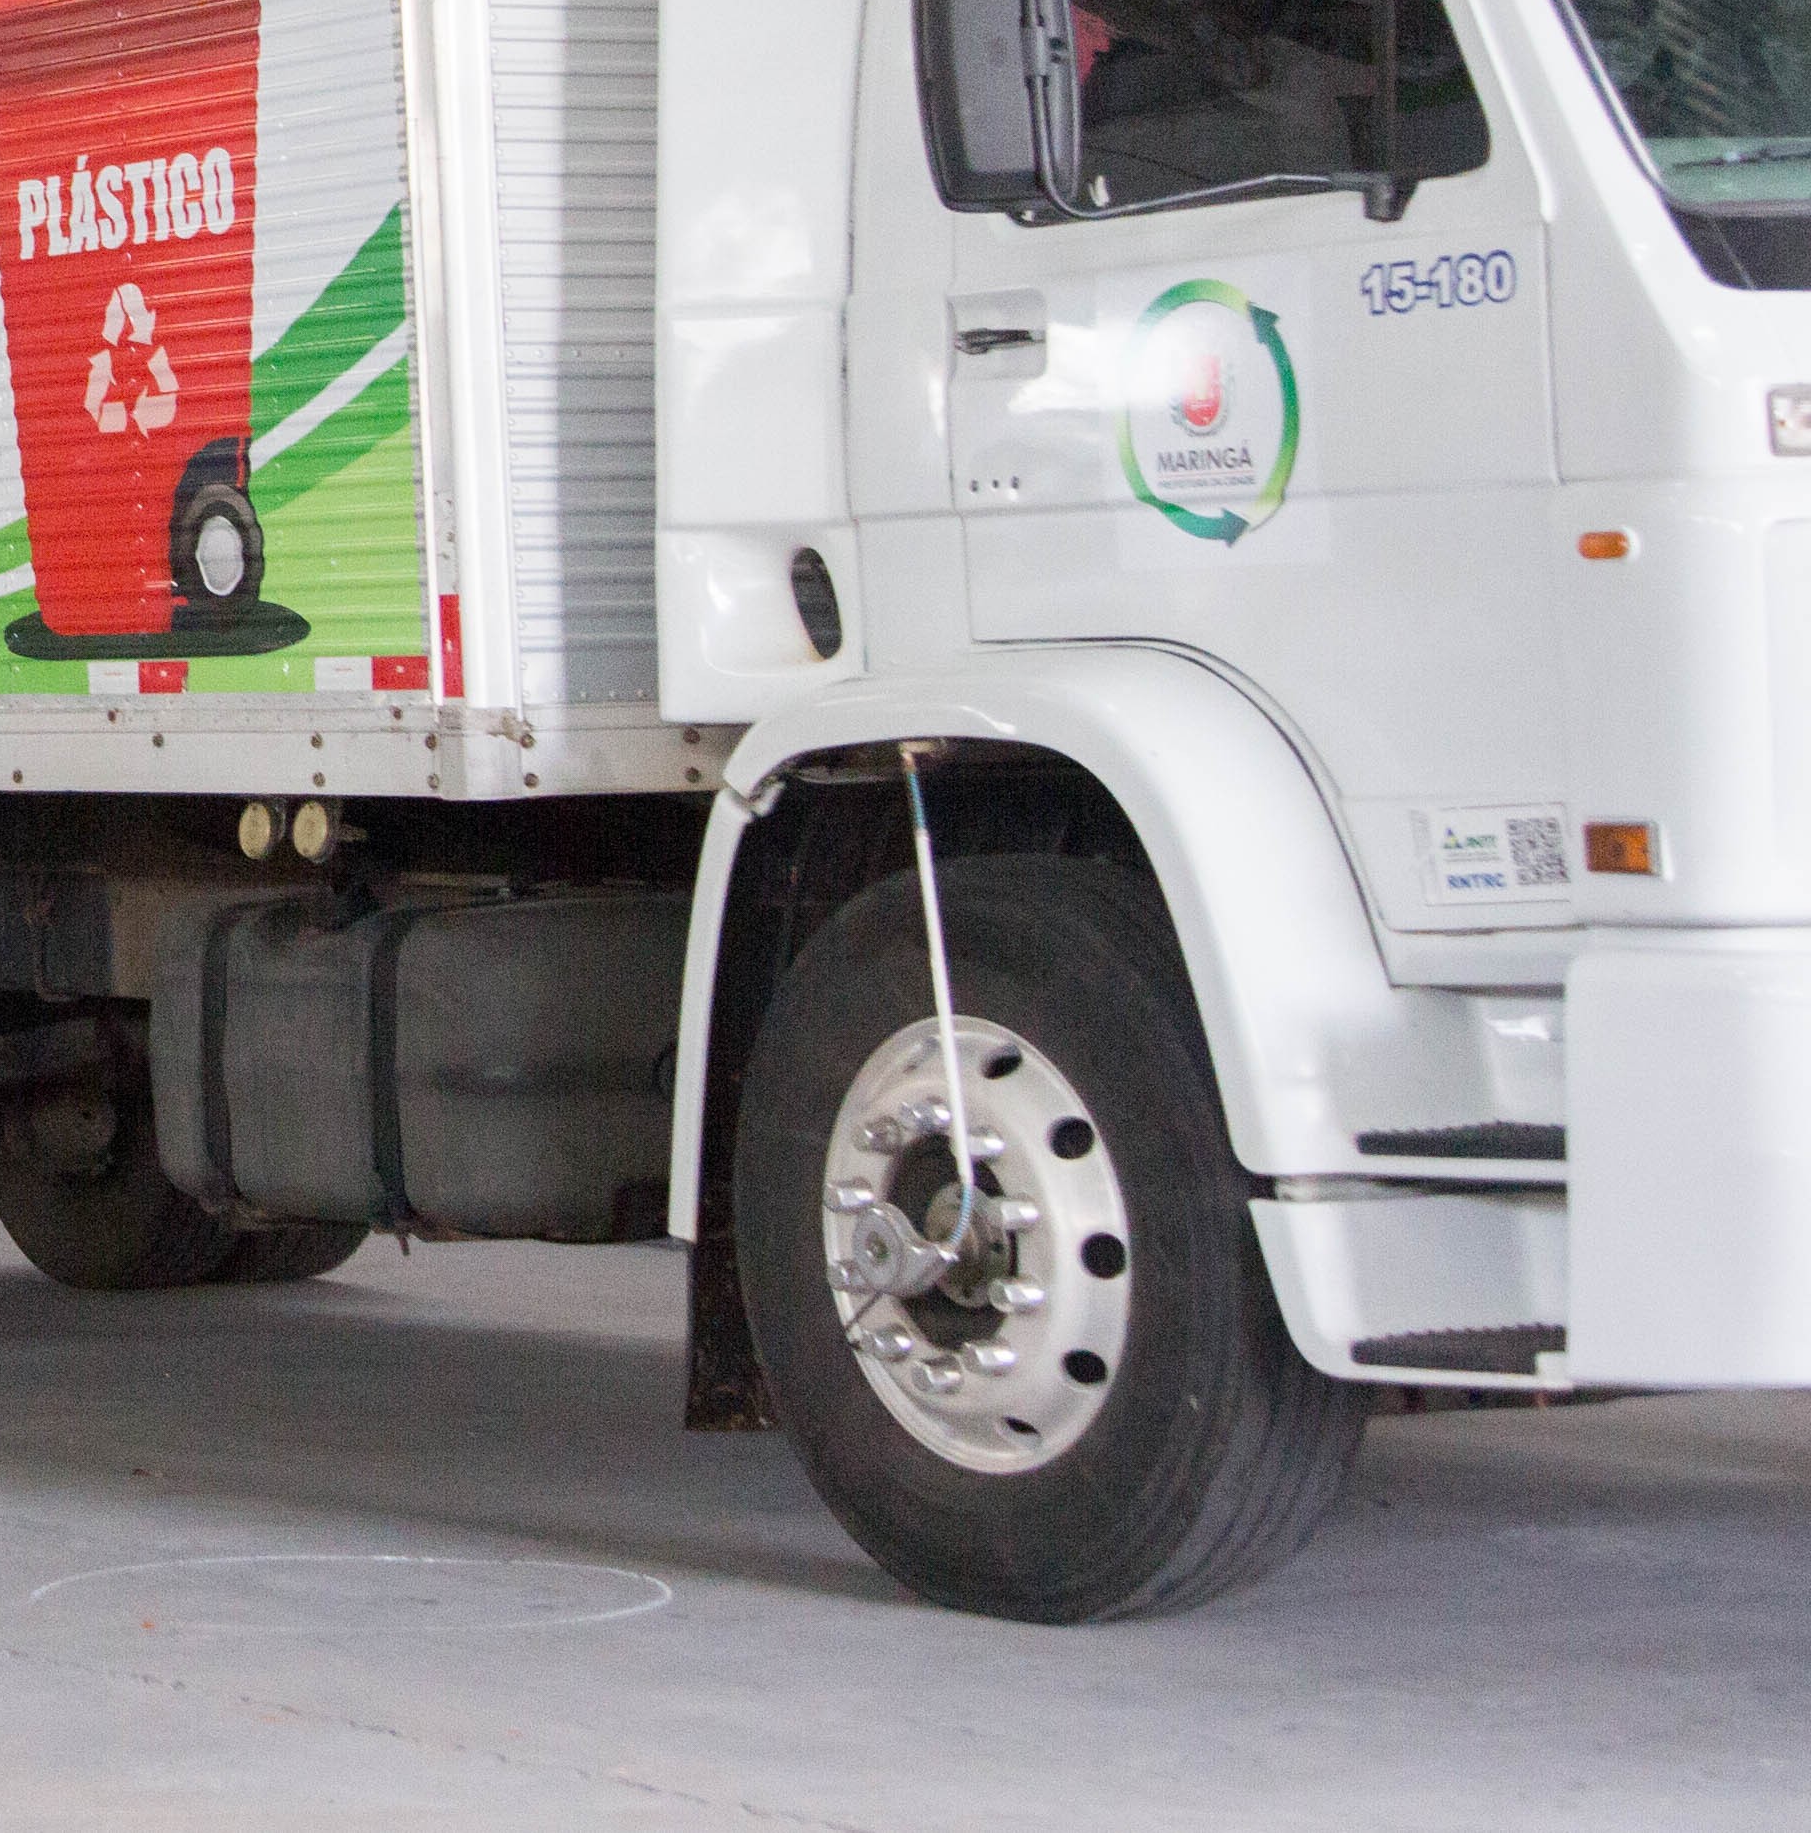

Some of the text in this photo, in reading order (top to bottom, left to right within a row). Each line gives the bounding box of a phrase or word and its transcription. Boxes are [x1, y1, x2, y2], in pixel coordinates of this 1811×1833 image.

[17, 147, 236, 261] PLÁSTICO
[1360, 249, 1517, 315] 15-180
[1157, 439, 1253, 473] MARINGÁ
